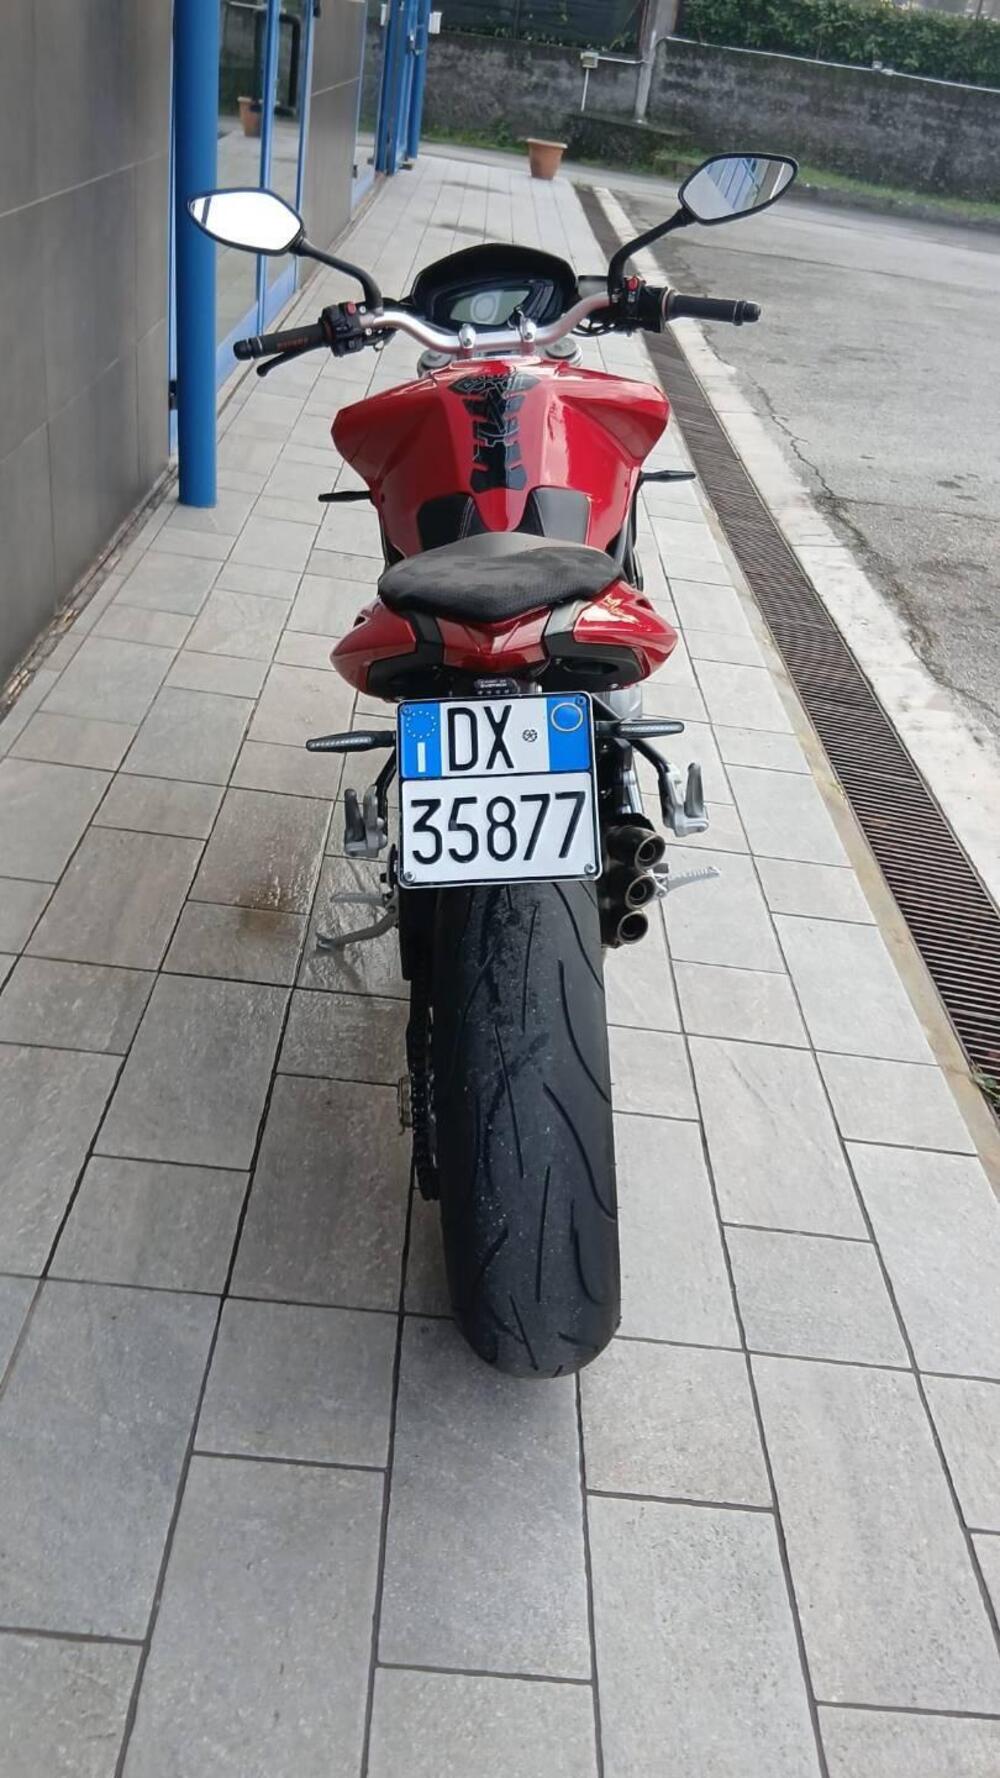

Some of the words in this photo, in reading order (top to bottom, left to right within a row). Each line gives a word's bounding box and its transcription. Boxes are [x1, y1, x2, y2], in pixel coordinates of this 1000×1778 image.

[417, 742, 426, 772] I
[447, 705, 514, 771] DX
[411, 791, 586, 865] 35877
